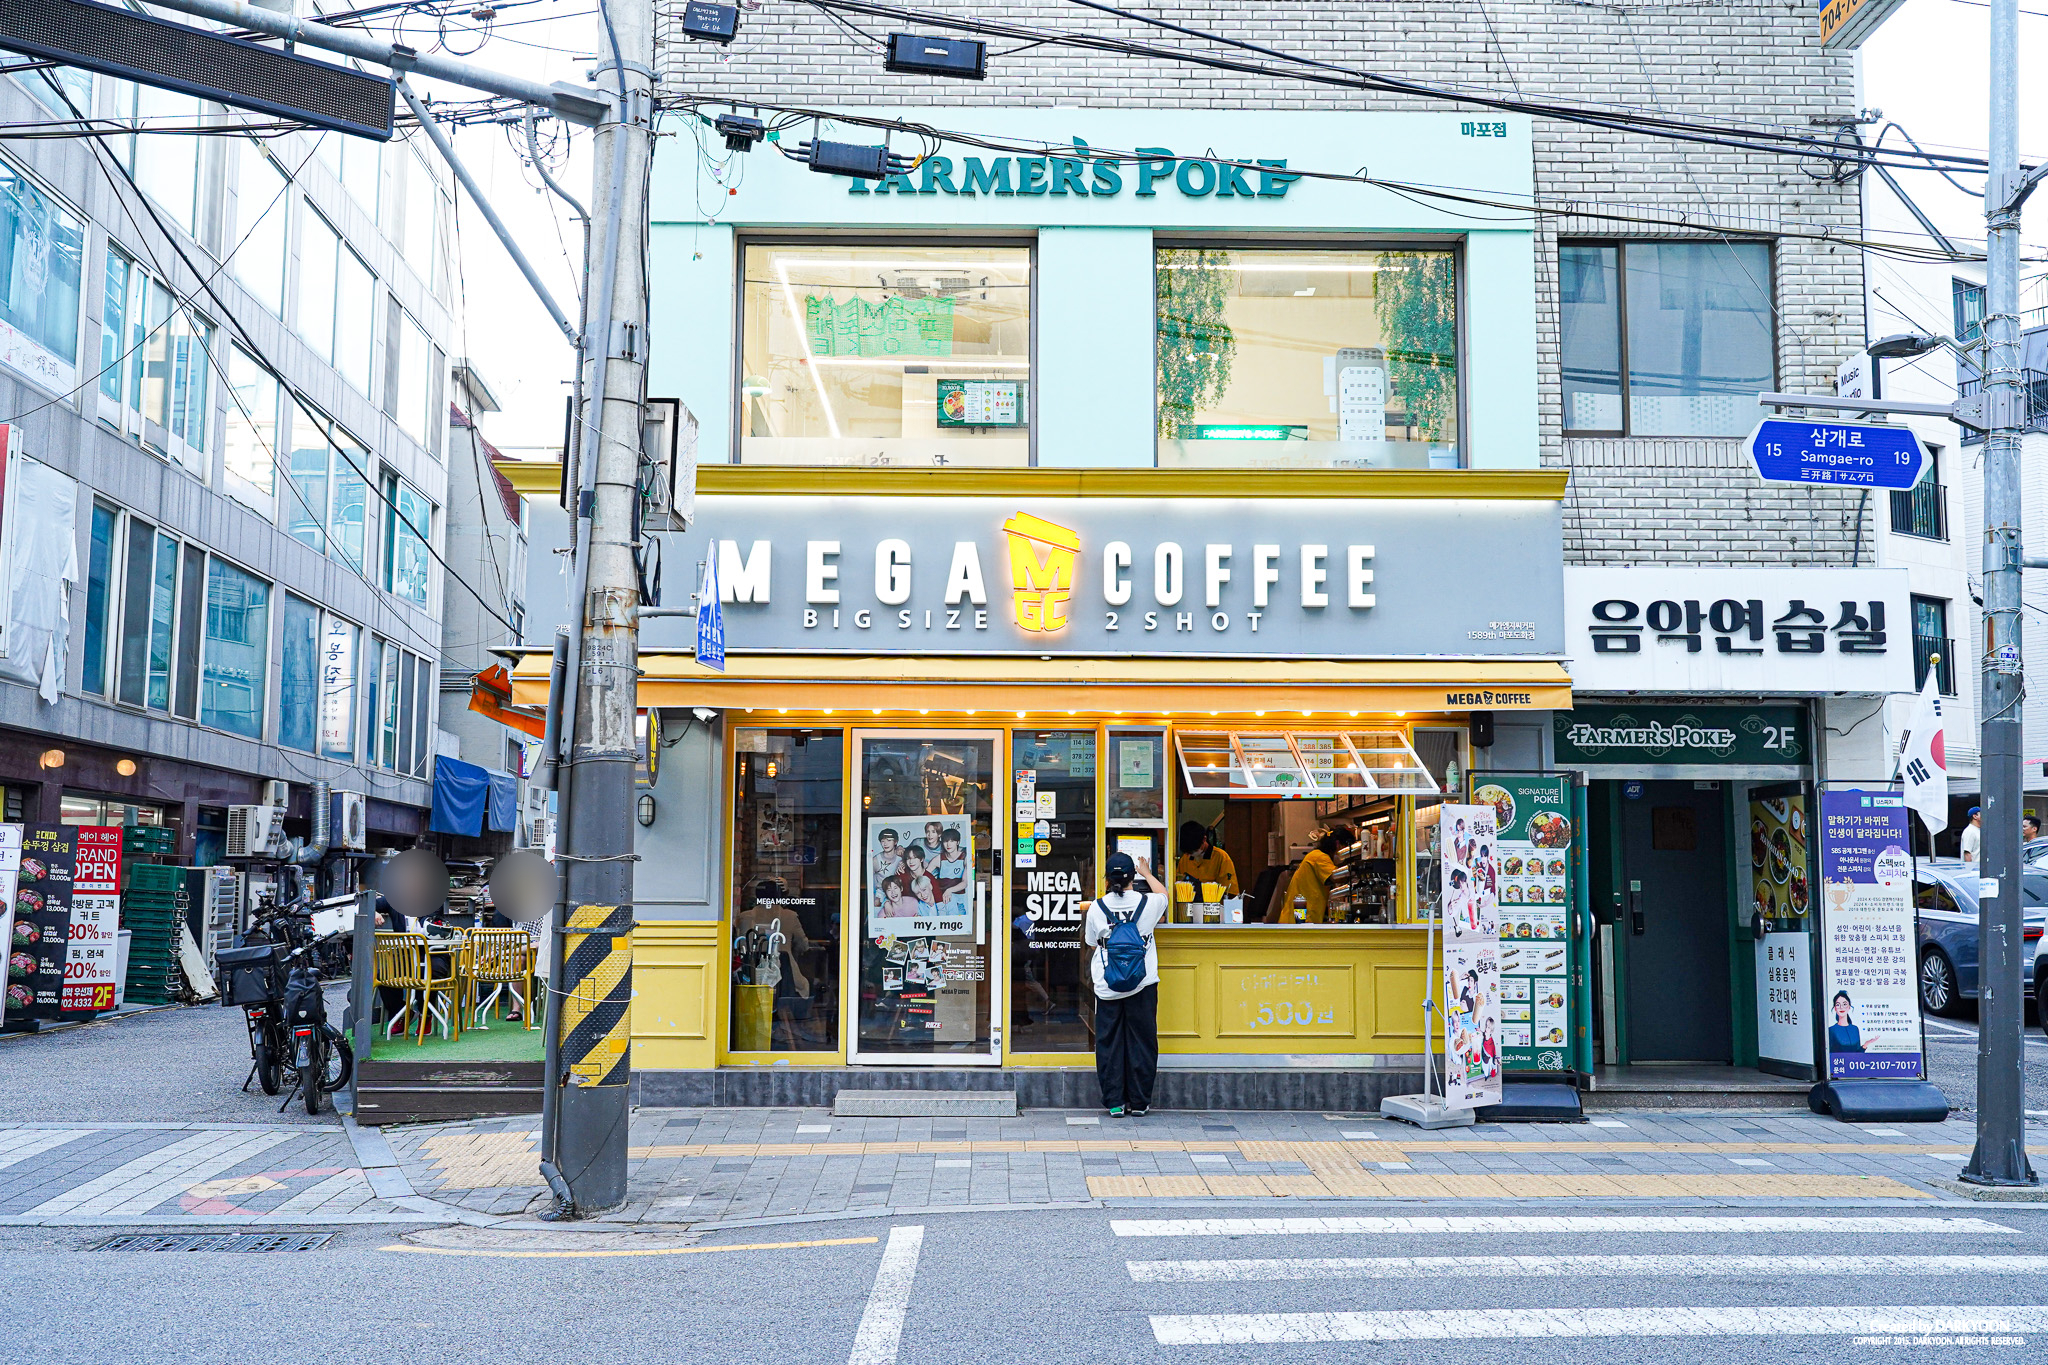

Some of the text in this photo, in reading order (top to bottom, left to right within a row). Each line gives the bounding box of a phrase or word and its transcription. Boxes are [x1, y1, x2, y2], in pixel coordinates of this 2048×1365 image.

[1461, 121, 1507, 138] 마포점
[1135, 146, 1302, 198] POKE
[1841, 367, 1860, 387] Music
[1810, 428, 1866, 448] 삼개로
[1765, 442, 1910, 466] 15 Samgae-ro 19
[1800, 469, 1832, 481] 三开路
[1839, 472, 1875, 483] サムゲロ
[716, 538, 988, 605] MEGA
[1103, 540, 1377, 608] COFFEE
[803, 608, 872, 629] BIG
[898, 609, 989, 629] SIZE
[1488, 621, 1535, 631] 메가엠지씨커피
[1588, 597, 1888, 655] 음악연습실
[1467, 630, 1535, 640] 1589th 마포도화점
[1446, 692, 1531, 705] MEGA COFFEE
[1567, 720, 1796, 749] FARMER'S POKE 2F
[1518, 787, 1559, 796] SIGNATURE
[1627, 785, 1640, 793] ADT
[1533, 795, 1560, 804] POKE
[1827, 815, 1890, 826] 말하기가 바뀌면
[40, 830, 58, 841] 대파
[100, 832, 118, 842] 헤어
[1828, 828, 1903, 839] 인생이 달라집니다!
[51, 841, 70, 853] 삼겹
[1837, 865, 1848, 873] 전문
[1847, 865, 1863, 873] 스피치
[1878, 868, 1909, 878] 스피치다
[1027, 871, 1082, 892] MEGA
[96, 899, 115, 909] 고객
[756, 897, 816, 905] MEGA MGC COFFEE
[1026, 893, 1082, 921] SIZE
[80, 911, 100, 921] 커트
[913, 921, 963, 931] my, mgc
[1025, 922, 1082, 936] Americano!
[101, 931, 113, 939] 할인
[1833, 933, 1906, 942] 위한 맞춤형 스피치 코칭
[1044, 941, 1082, 949] MGC COFFEE
[72, 949, 104, 960] 펌, 염색
[1767, 945, 1795, 961] 클래식
[1835, 955, 1906, 964] 프레젠테이션 전문 강의
[64, 962, 111, 979] 20% 할인
[1768, 966, 1796, 983] 실용음악
[1893, 968, 1907, 977] 극복
[1892, 978, 1906, 986] 교정
[74, 985, 113, 1007] 우선제 2F
[1768, 988, 1797, 1004] 공간대여
[73, 998, 93, 1008] 4332
[1769, 1008, 1798, 1026] 개인레슨
[1833, 1058, 1918, 1070] 상시 010-2107-7017
[1833, 1066, 1846, 1074] 문의
